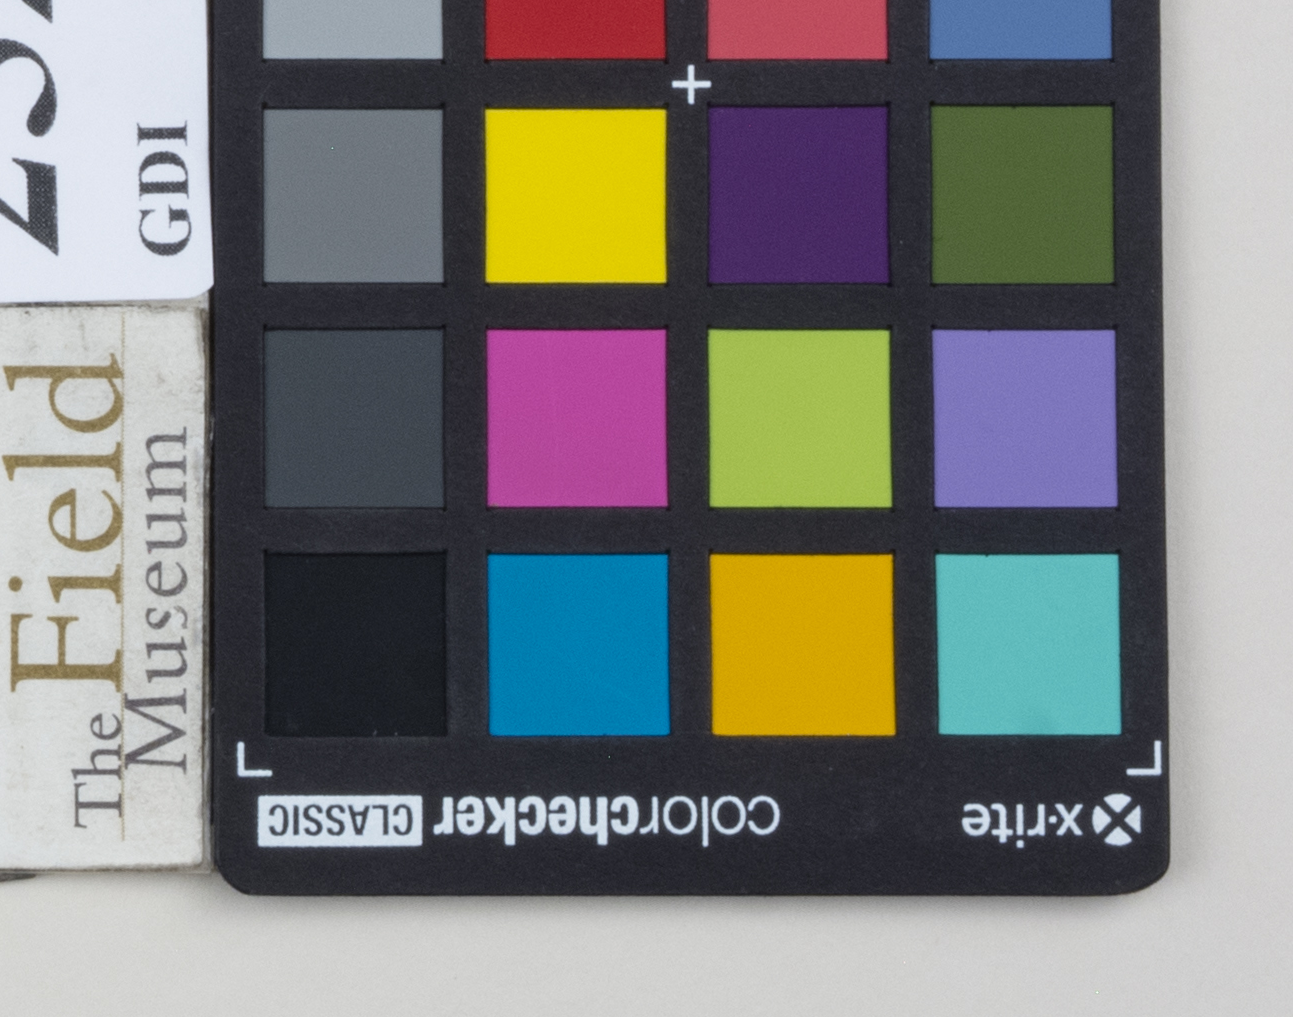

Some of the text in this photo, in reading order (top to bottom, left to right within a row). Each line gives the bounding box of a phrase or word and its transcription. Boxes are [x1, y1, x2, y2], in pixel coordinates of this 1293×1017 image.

[136, 120, 192, 257] GDI
[1, 352, 124, 830] The Field
[124, 426, 189, 775] Museum
[269, 795, 781, 848] colorchecker CLASSIC
